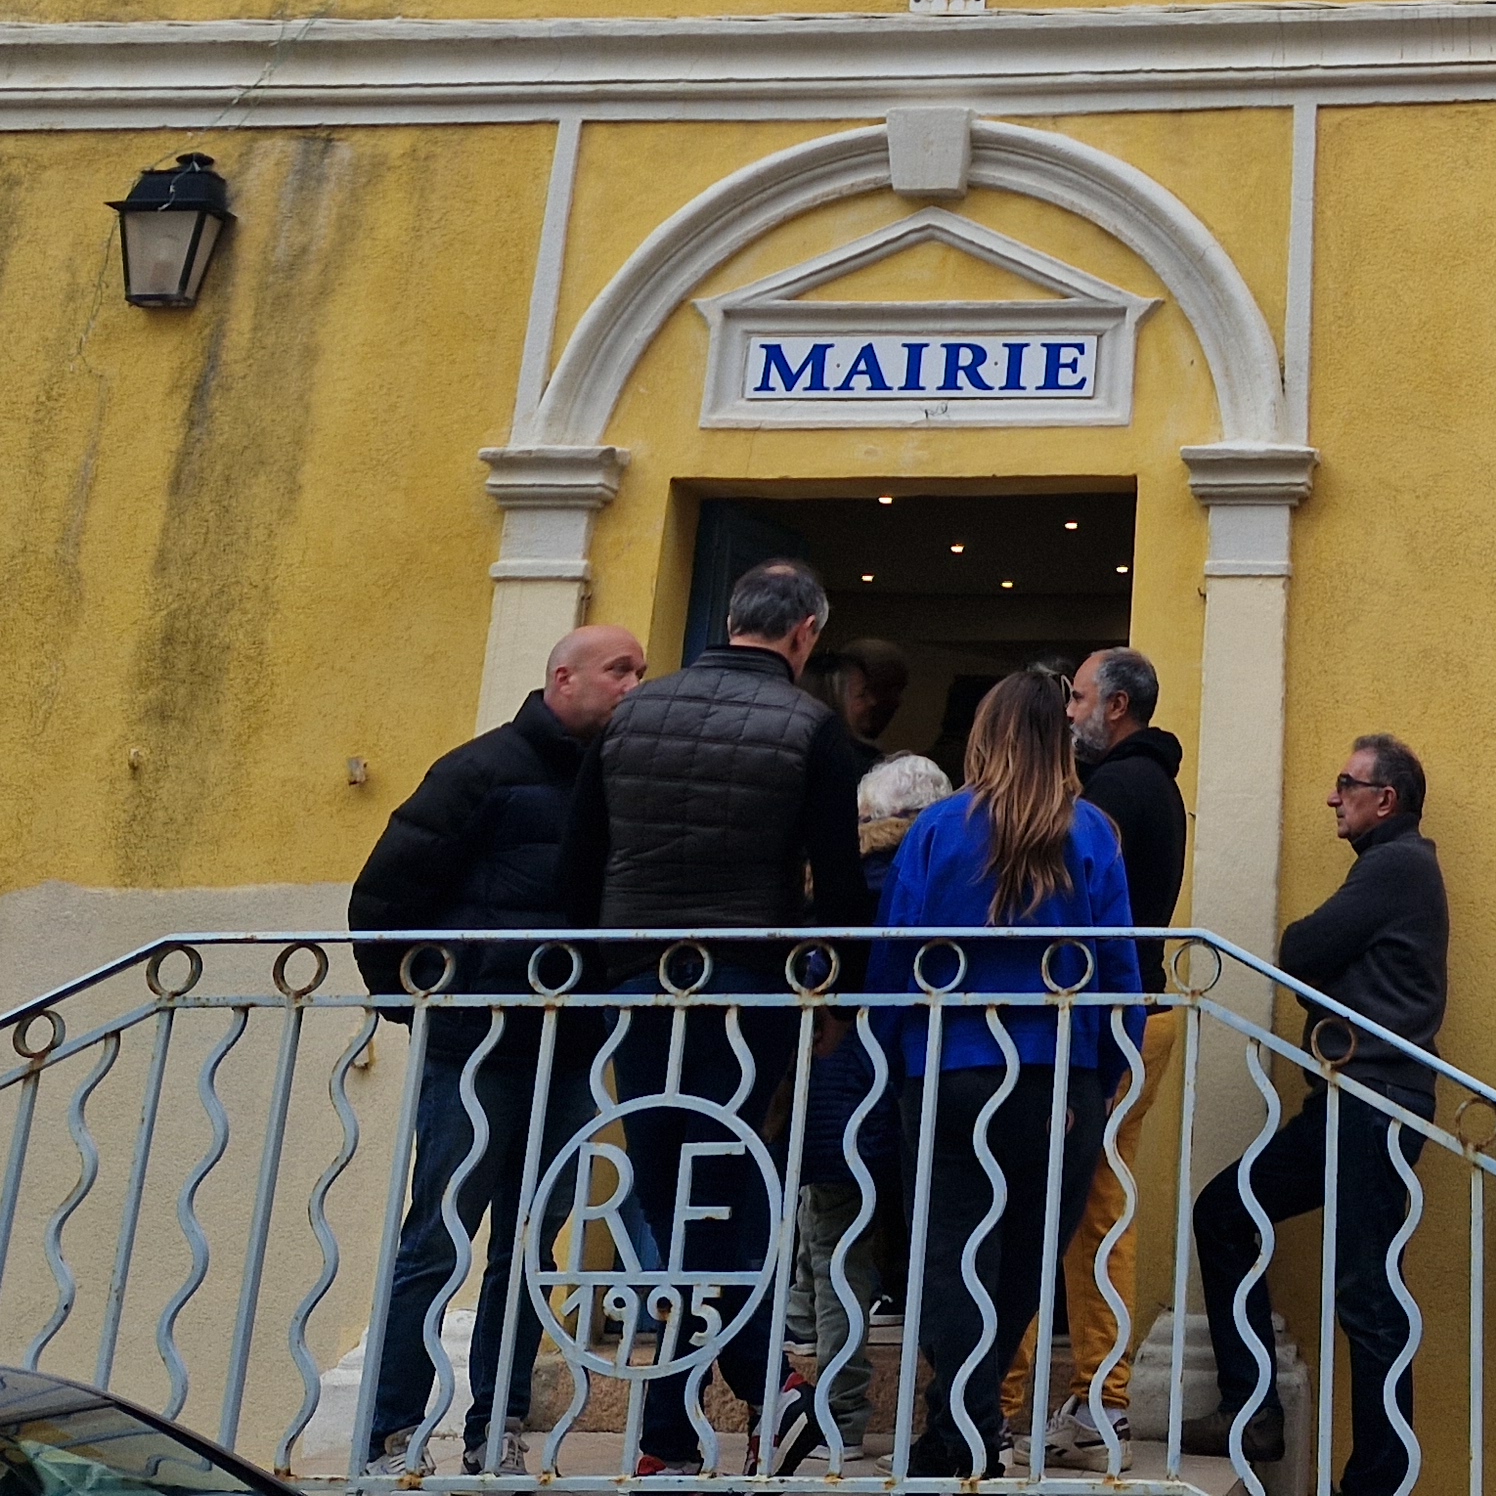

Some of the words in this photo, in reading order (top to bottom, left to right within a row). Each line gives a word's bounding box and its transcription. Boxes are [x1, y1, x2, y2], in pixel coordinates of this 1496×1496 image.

[753, 342, 1088, 392] MAIRIE
[565, 1141, 746, 1272] RF
[560, 1284, 722, 1367] 1995
